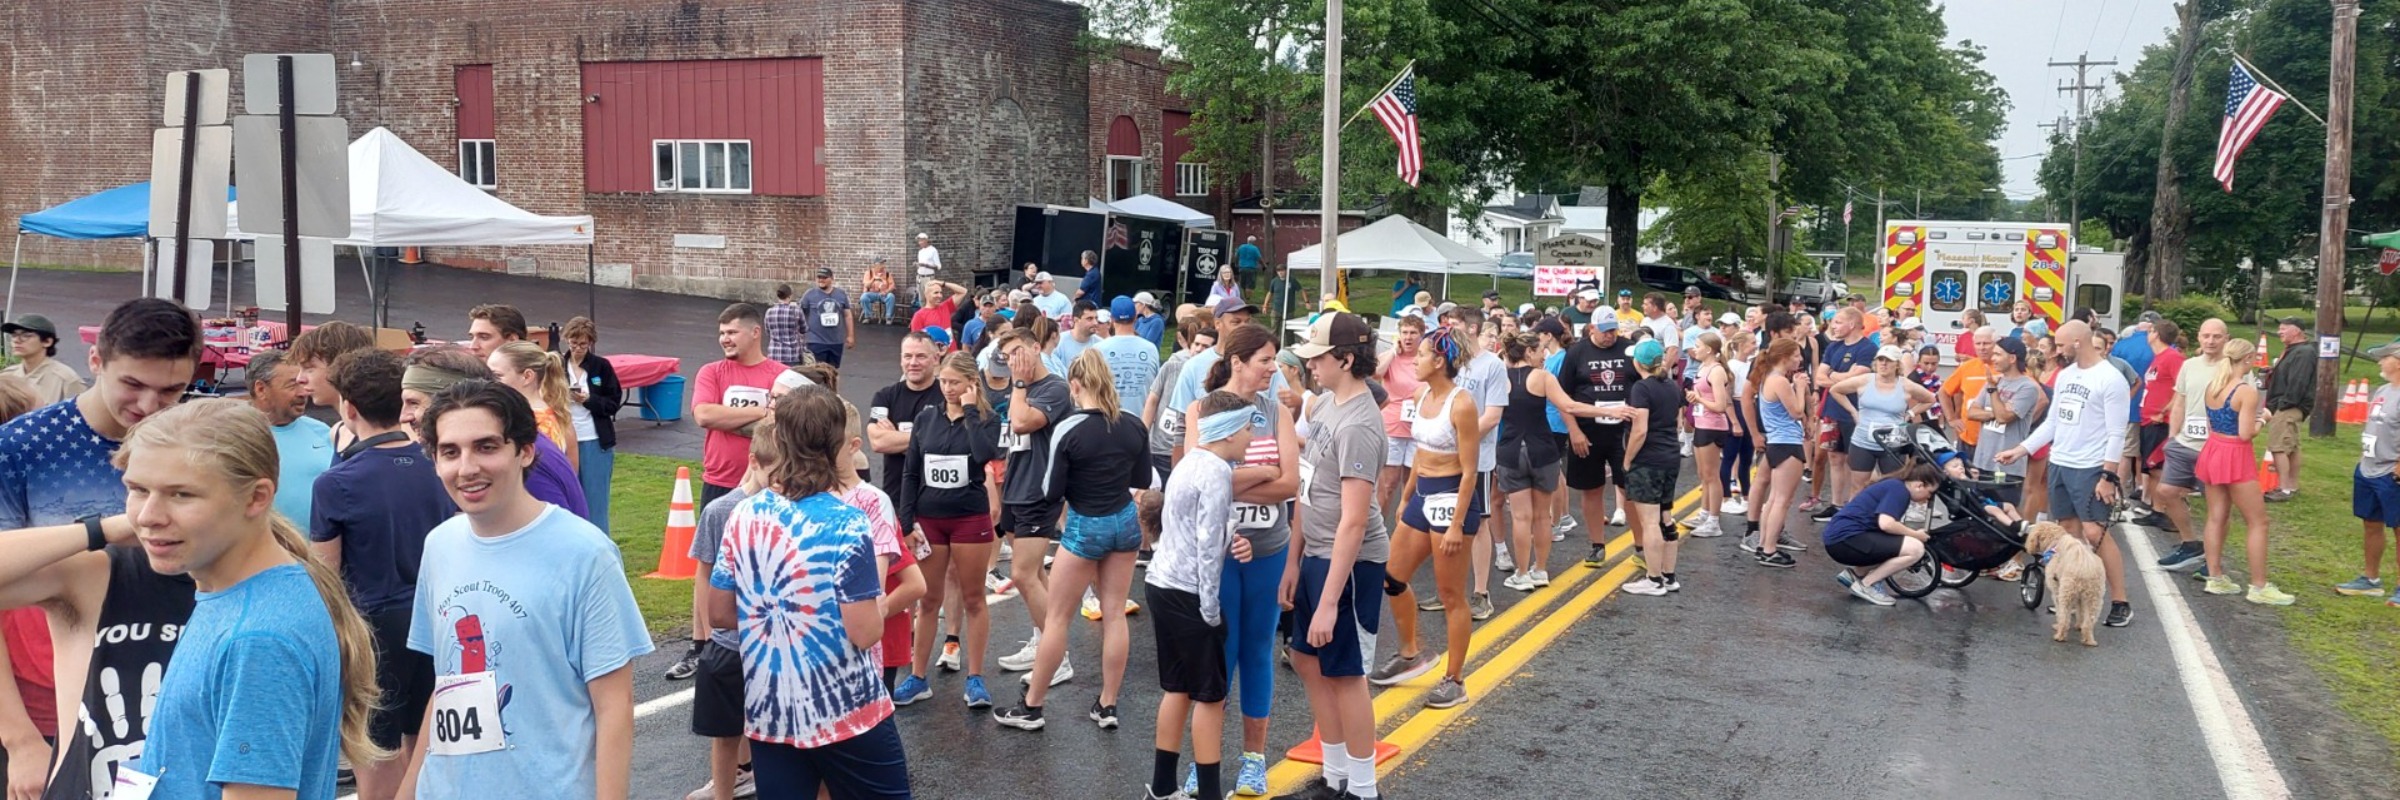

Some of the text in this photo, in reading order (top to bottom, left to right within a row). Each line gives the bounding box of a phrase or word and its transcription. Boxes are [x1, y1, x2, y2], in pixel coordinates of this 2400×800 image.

[1937, 252, 2014, 263] Pleasant Mount
[2031, 260, 2060, 270] 28-3
[1588, 359, 1624, 370] TNT
[2187, 424, 2207, 436] 833
[931, 469, 960, 483] 803
[1236, 505, 1271, 523] 779
[1429, 507, 1455, 521] 739
[453, 581, 480, 598] Scout
[482, 580, 511, 603] Troop
[508, 599, 529, 620] 407
[95, 622, 153, 648] YOU
[436, 706, 483, 743] 804
